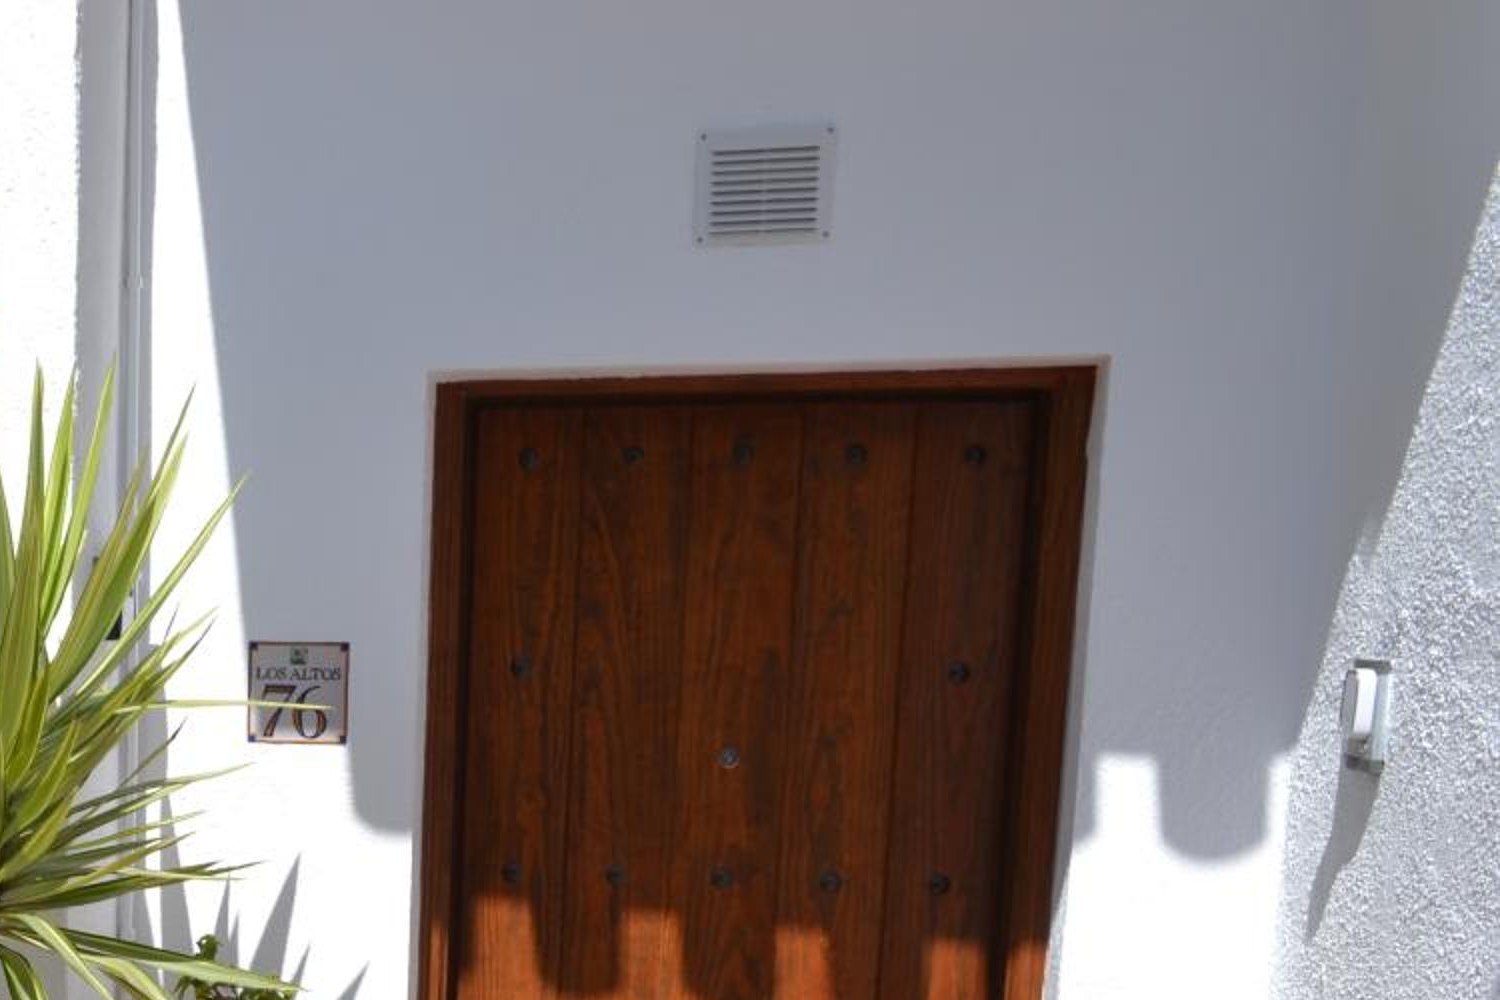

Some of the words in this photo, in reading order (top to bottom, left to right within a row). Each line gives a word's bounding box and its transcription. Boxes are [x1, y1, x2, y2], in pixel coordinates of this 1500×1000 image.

[256, 667, 287, 680] LOS
[290, 667, 341, 681] ALTOS
[261, 684, 327, 739] 76
